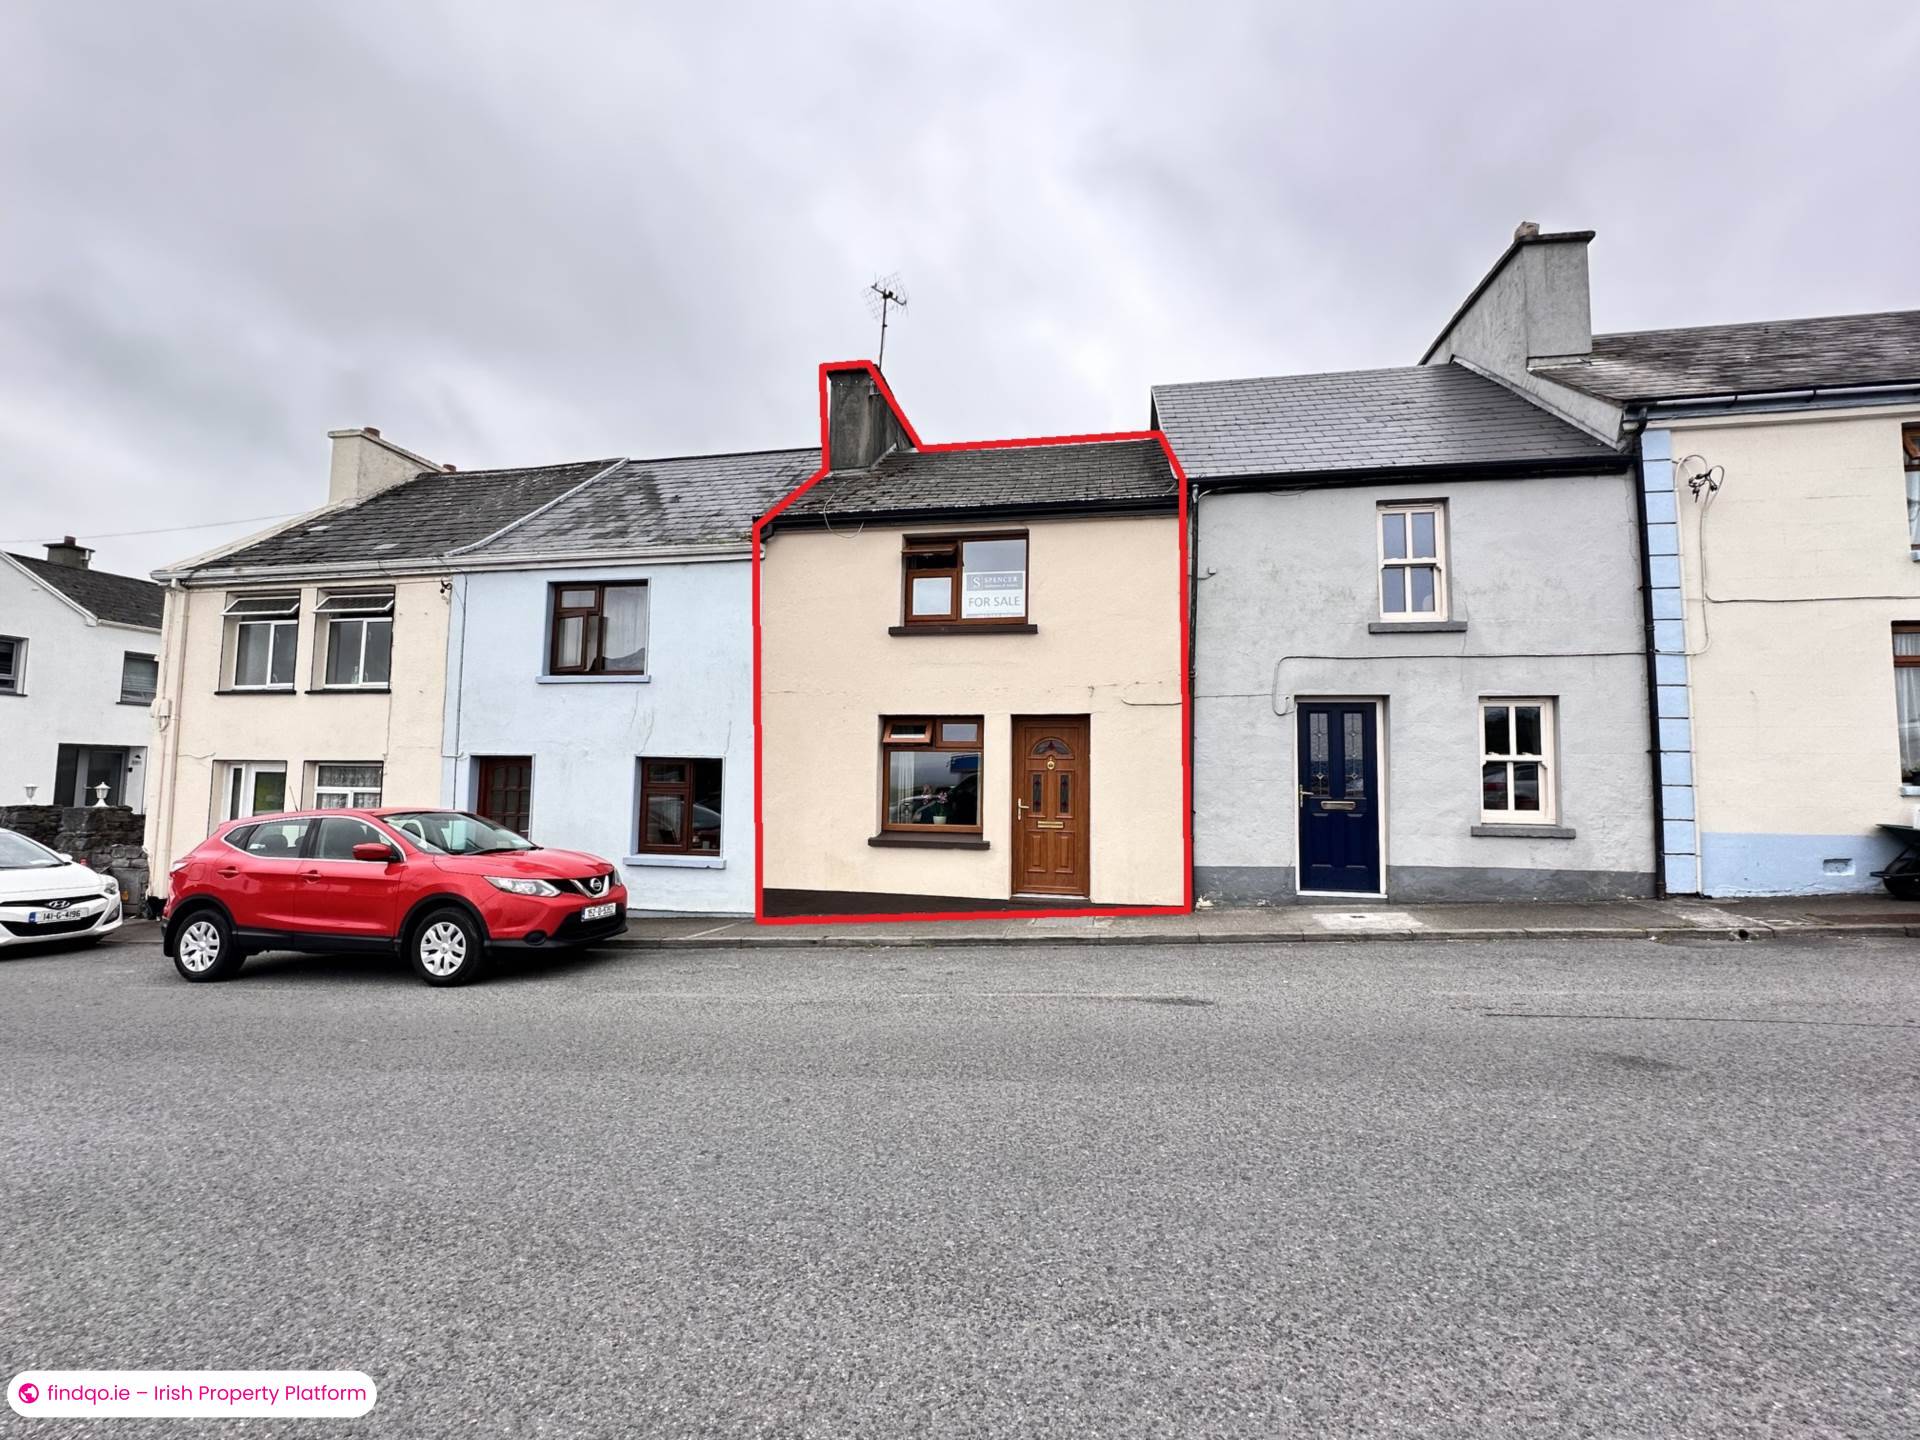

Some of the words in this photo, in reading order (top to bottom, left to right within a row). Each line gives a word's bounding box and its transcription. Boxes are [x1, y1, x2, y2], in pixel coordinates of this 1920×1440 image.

[968, 597, 990, 608] FOR
[994, 596, 1021, 607] SALE
[43, 910, 81, 920] 141-G-4196
